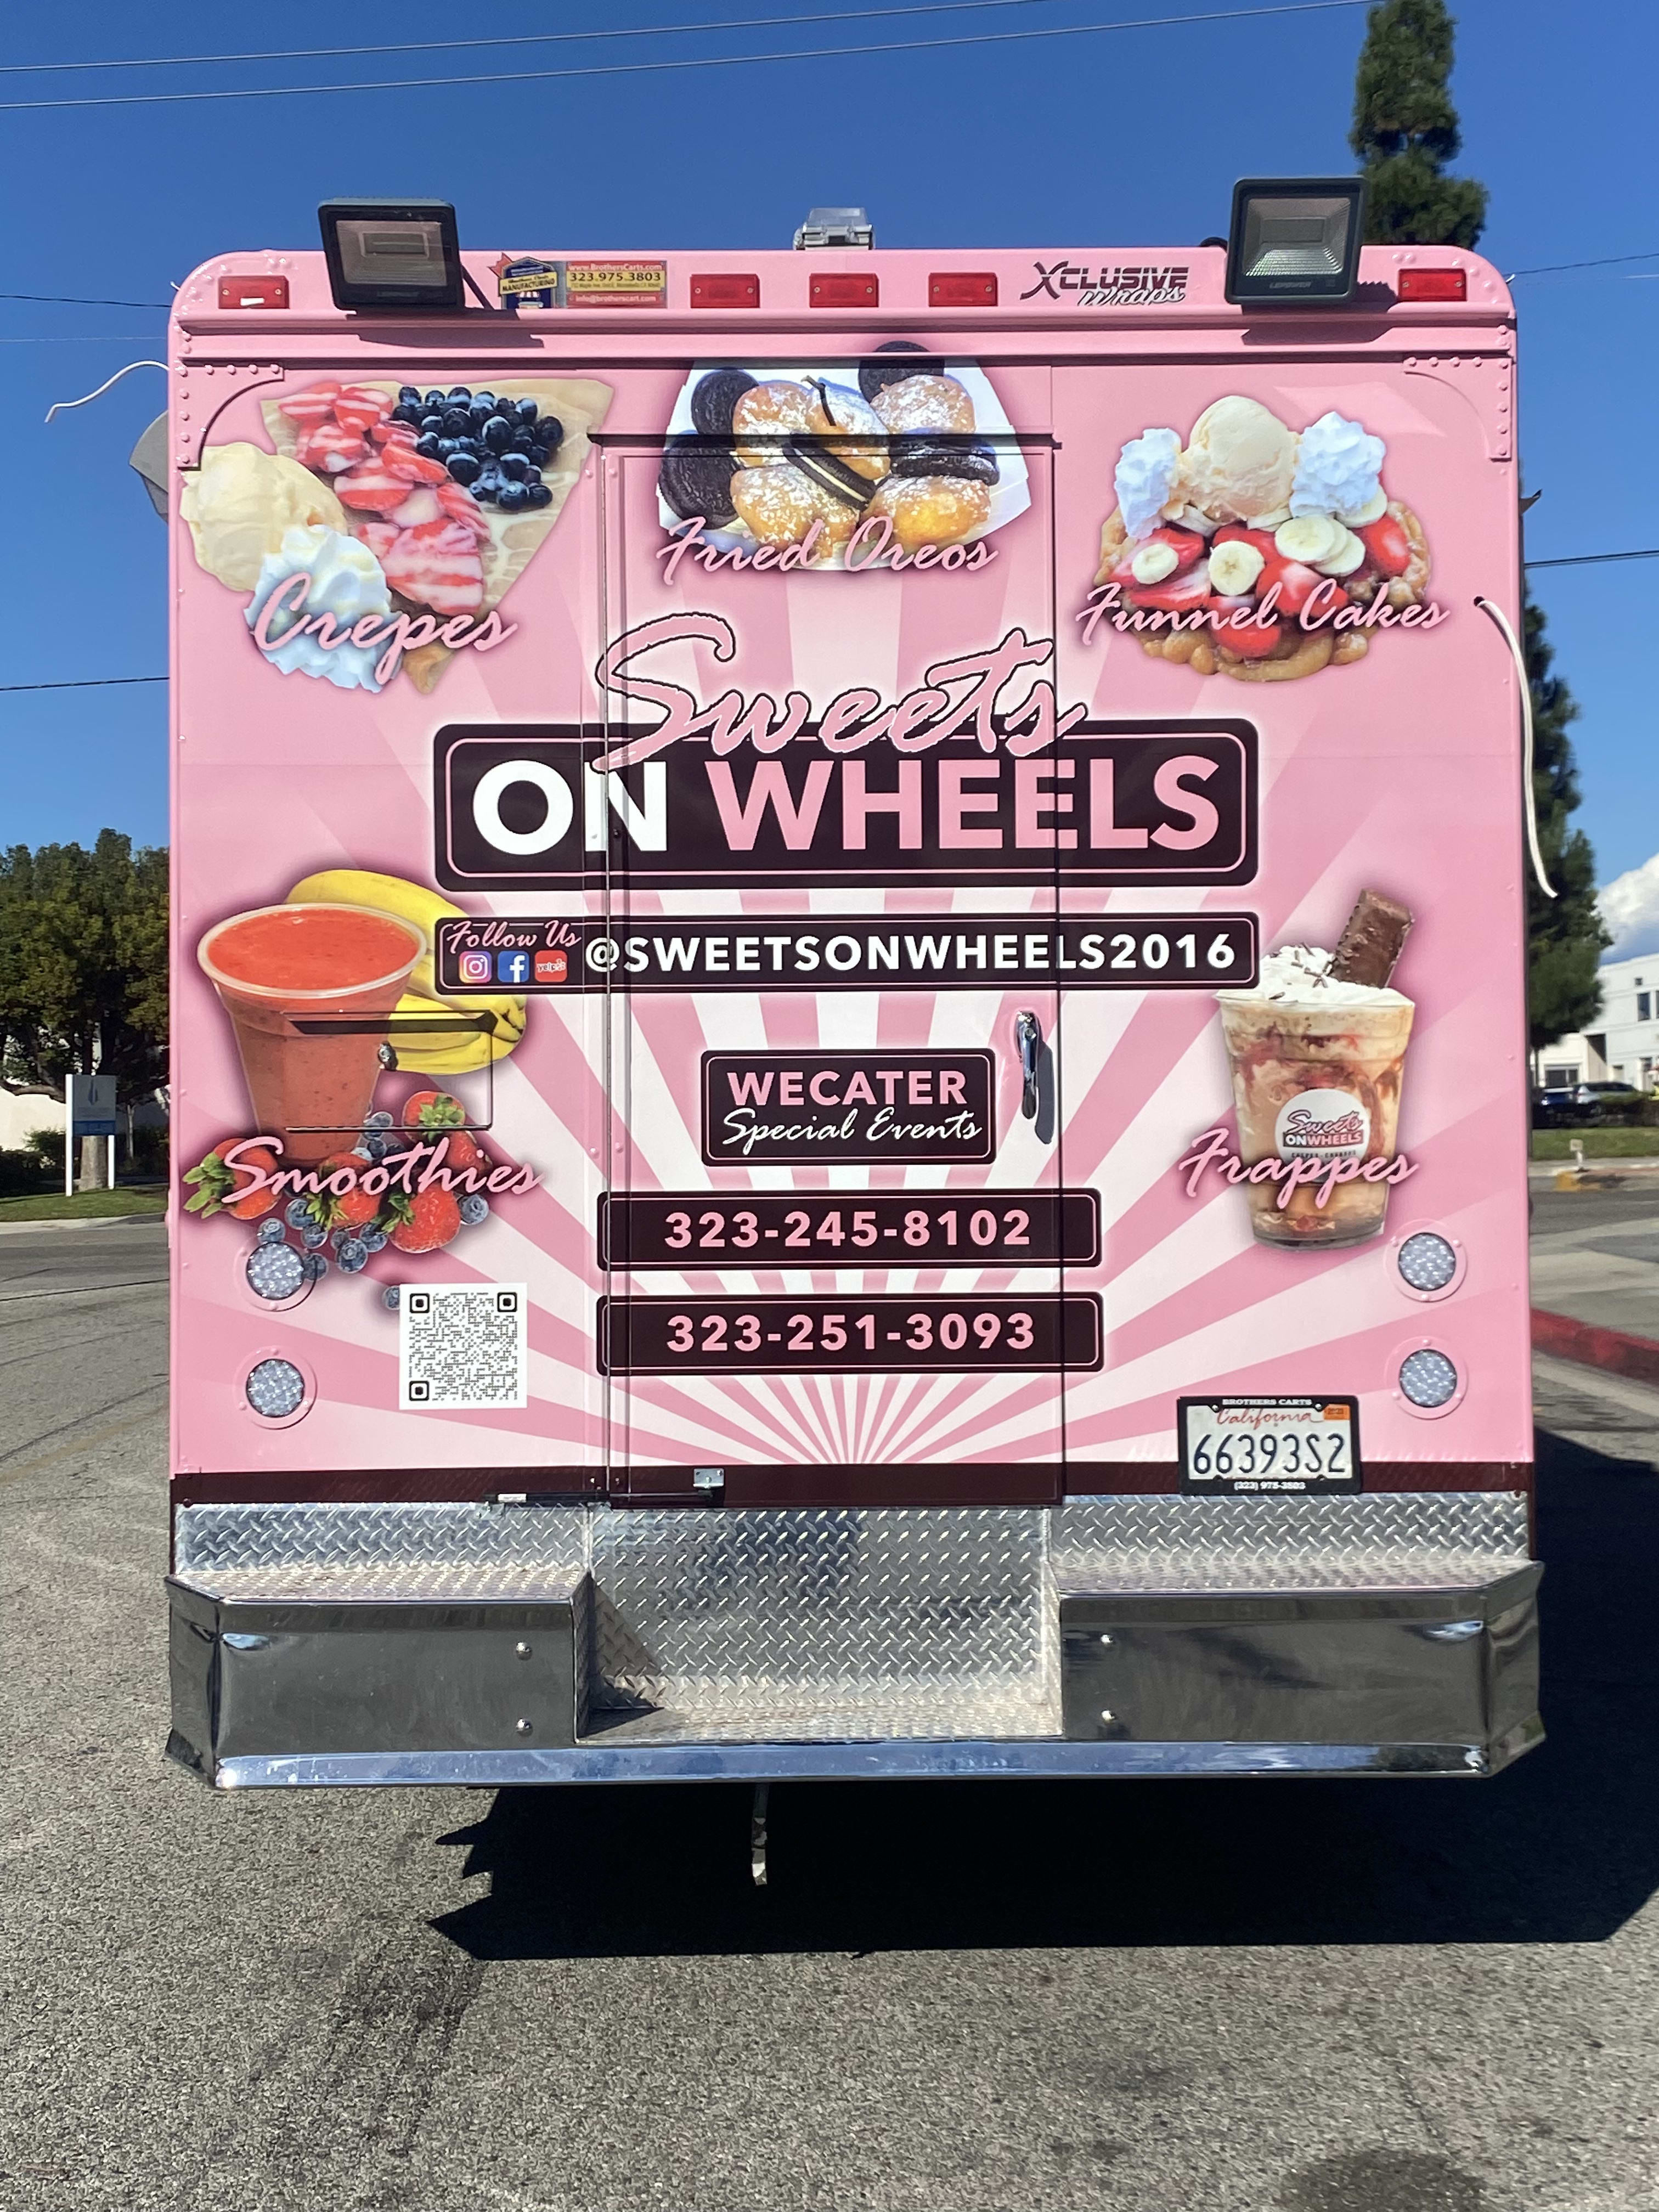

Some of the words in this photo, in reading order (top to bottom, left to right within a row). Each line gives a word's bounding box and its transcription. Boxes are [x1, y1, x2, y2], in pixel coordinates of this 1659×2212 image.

[503, 278, 555, 291] MANUFACTURING
[570, 273, 661, 281] 323.975.3803
[656, 516, 826, 585] Fried
[844, 516, 998, 572] Oreos
[253, 572, 518, 685] Crepes
[1075, 582, 1278, 646] Funnel
[1299, 578, 1451, 631] Cakes
[591, 612, 1087, 771] Sweets
[473, 759, 667, 855] ON
[706, 755, 1220, 851] WHEELS
[447, 921, 538, 954] Follow
[545, 920, 582, 947] Us
[585, 933, 1235, 974] @SWEETSONWHEELS2016
[723, 1107, 859, 1155] Special
[866, 1107, 983, 1141] Events
[1286, 1109, 1363, 1133] Sweets
[221, 1136, 544, 1203] Smoothies
[1179, 1128, 1419, 1209] Frappes
[664, 1210, 1030, 1249] 323-245-8102
[667, 1312, 1034, 1352] 323-251-3093
[1216, 1408, 1324, 1430] California
[1193, 1433, 1345, 1474] 66393S2
